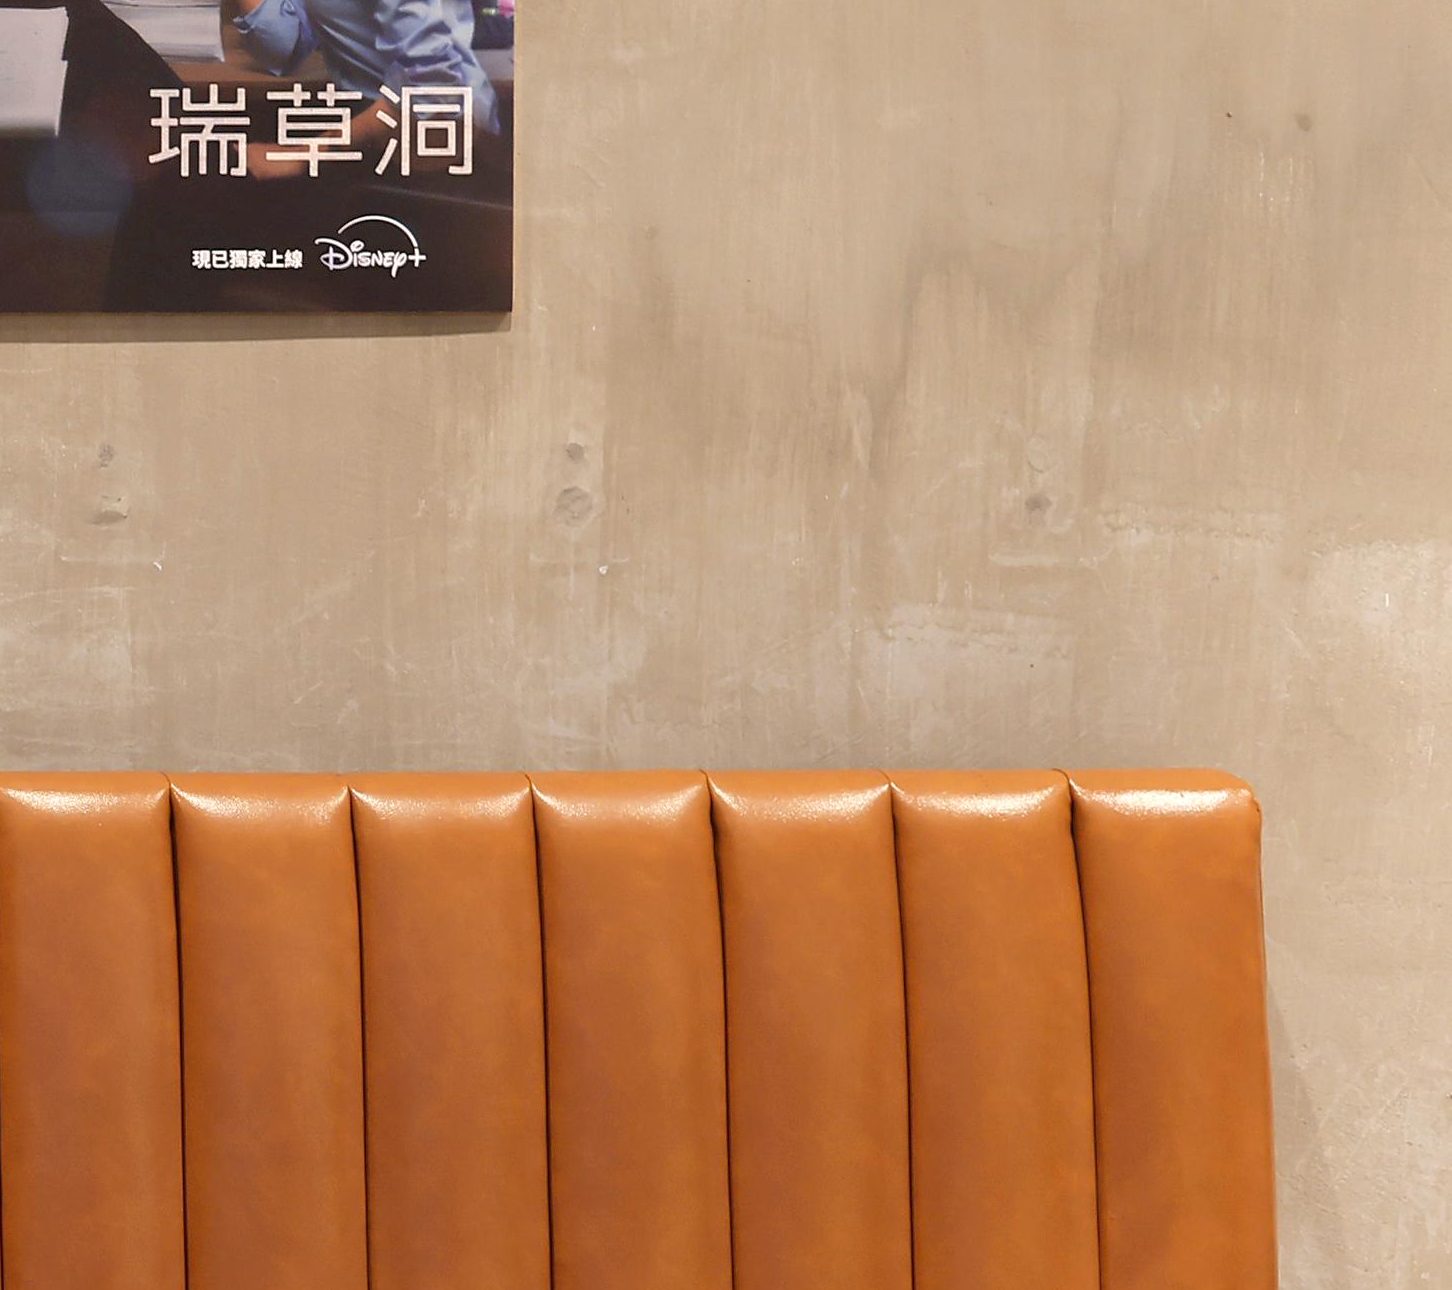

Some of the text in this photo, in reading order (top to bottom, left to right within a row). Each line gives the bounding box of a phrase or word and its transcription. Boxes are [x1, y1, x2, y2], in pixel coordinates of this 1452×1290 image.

[148, 83, 473, 177] 瑞草洞
[192, 249, 303, 269] 現已獨家上線
[314, 237, 427, 278] Disney+
